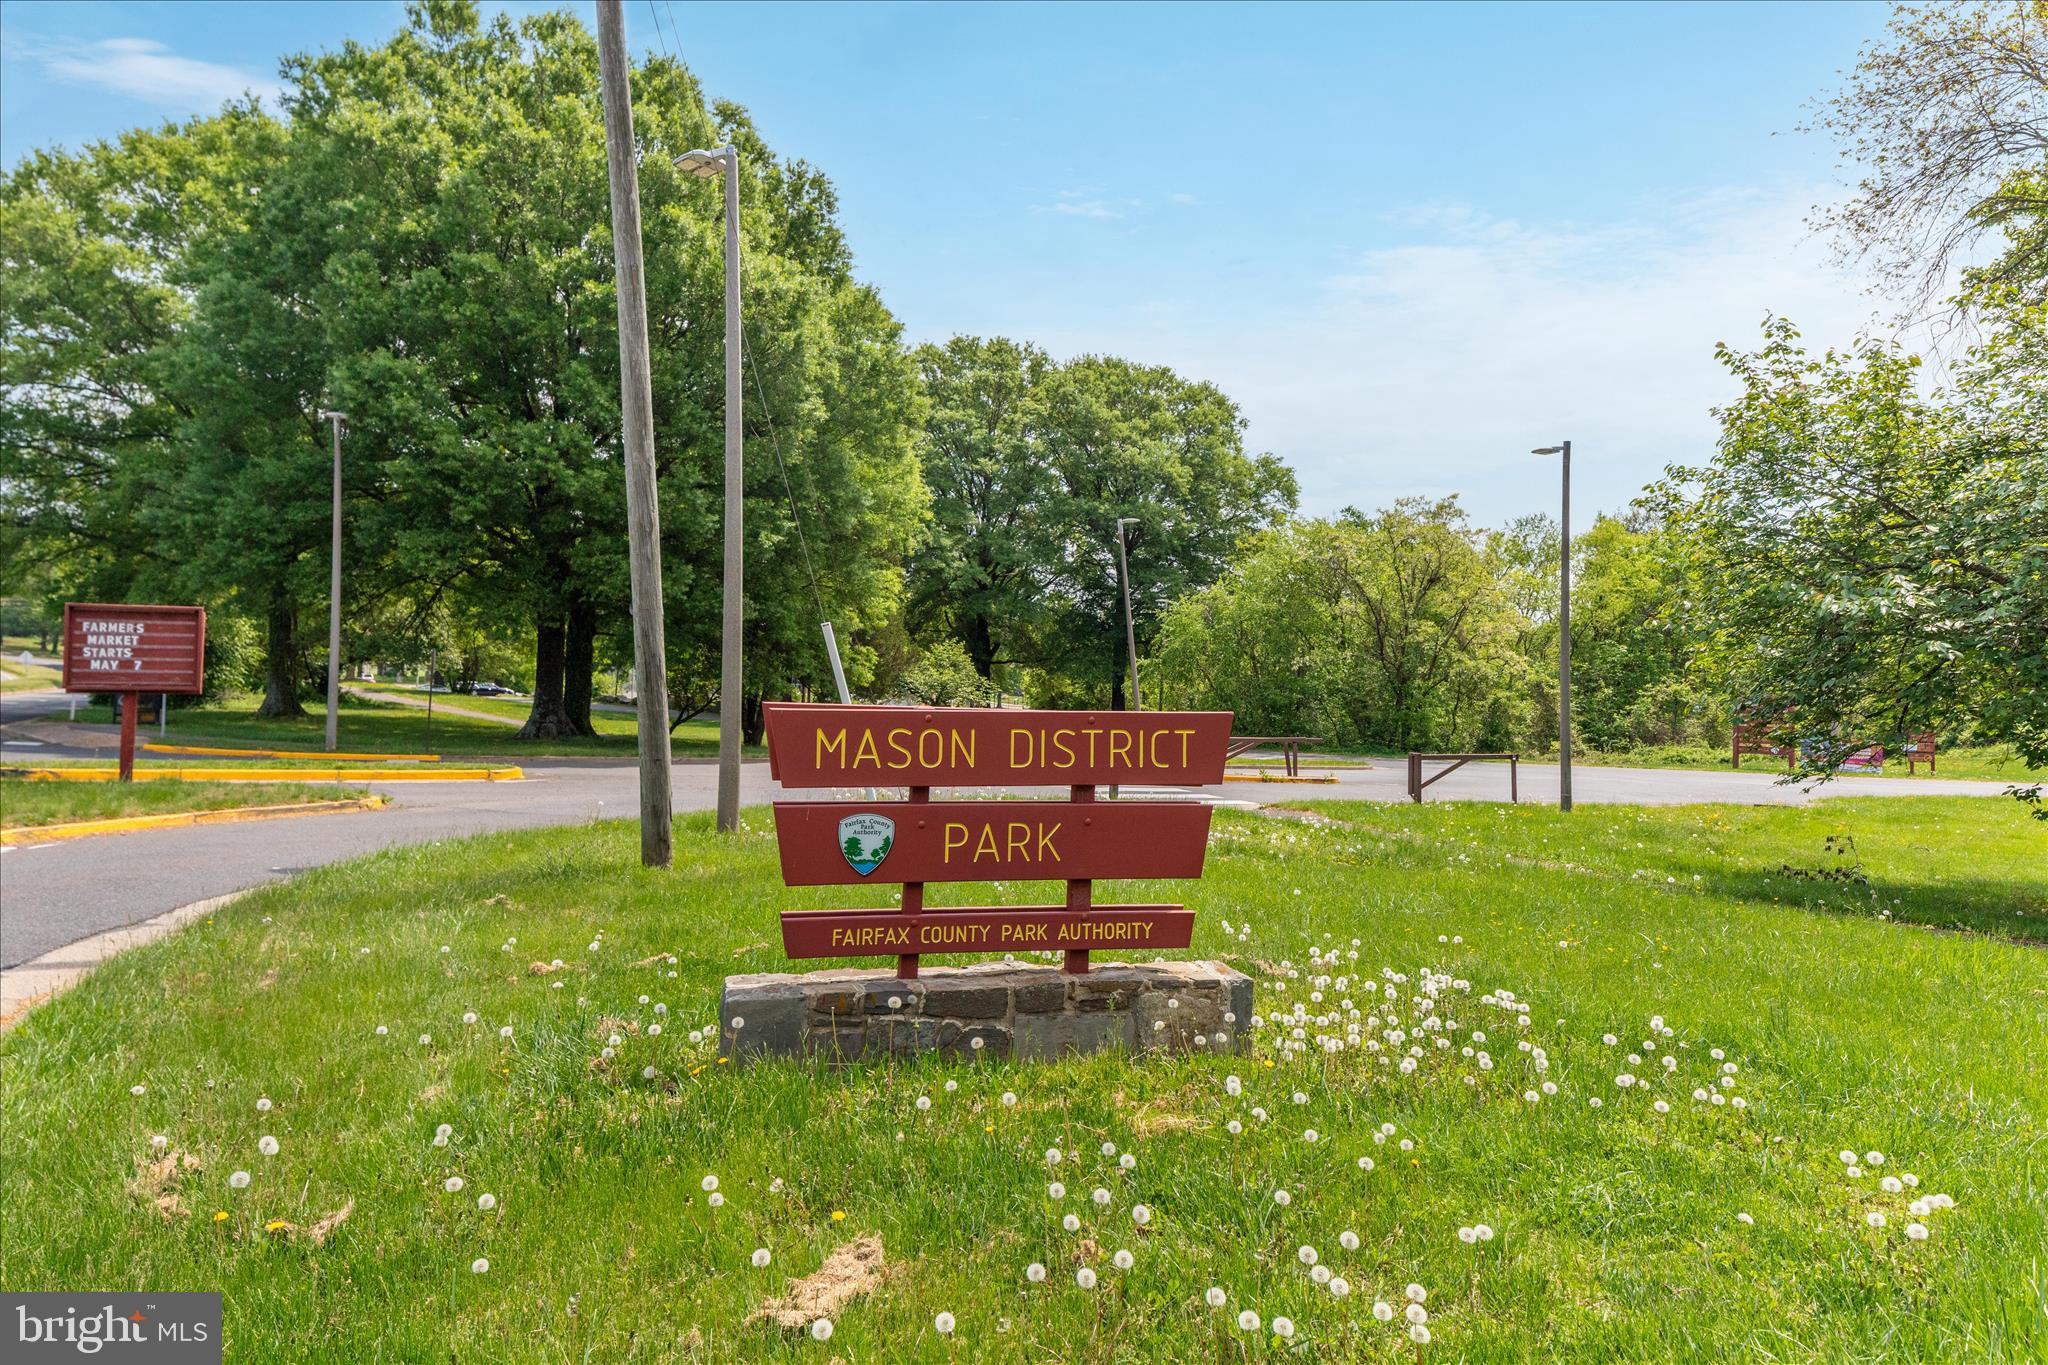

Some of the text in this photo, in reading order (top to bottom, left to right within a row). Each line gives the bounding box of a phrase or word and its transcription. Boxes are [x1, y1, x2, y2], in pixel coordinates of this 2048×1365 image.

[82, 621, 145, 634] FARMERS
[87, 634, 140, 646] MARKET
[82, 646, 133, 658] STARTS
[90, 659, 142, 671] MAY 7
[815, 727, 1196, 769] MASON DISTRICT
[844, 818, 891, 830] Fairfax County
[852, 829, 882, 837] Authority
[944, 822, 1062, 863] PARK
[832, 921, 1153, 946] FAIRFAX COUNTY PARK AUTHORITY
